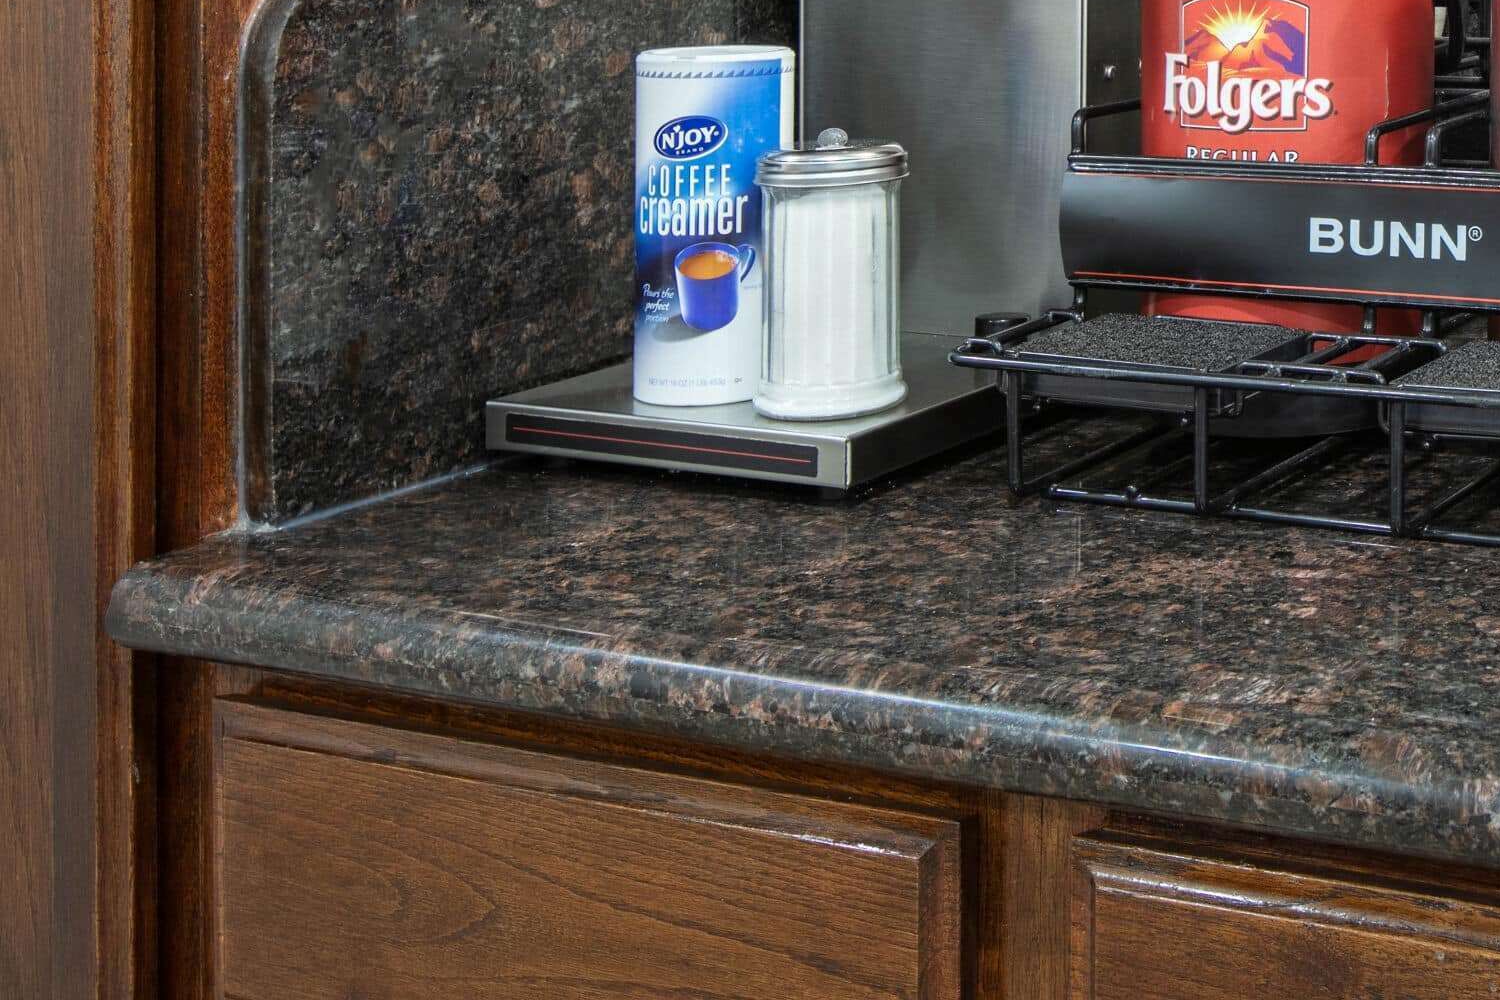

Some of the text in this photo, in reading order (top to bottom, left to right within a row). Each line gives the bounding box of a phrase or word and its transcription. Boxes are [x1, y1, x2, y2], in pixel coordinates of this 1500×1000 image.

[1162, 51, 1335, 133] Folgers
[648, 163, 732, 197] COFFEE
[639, 194, 749, 237] creamer
